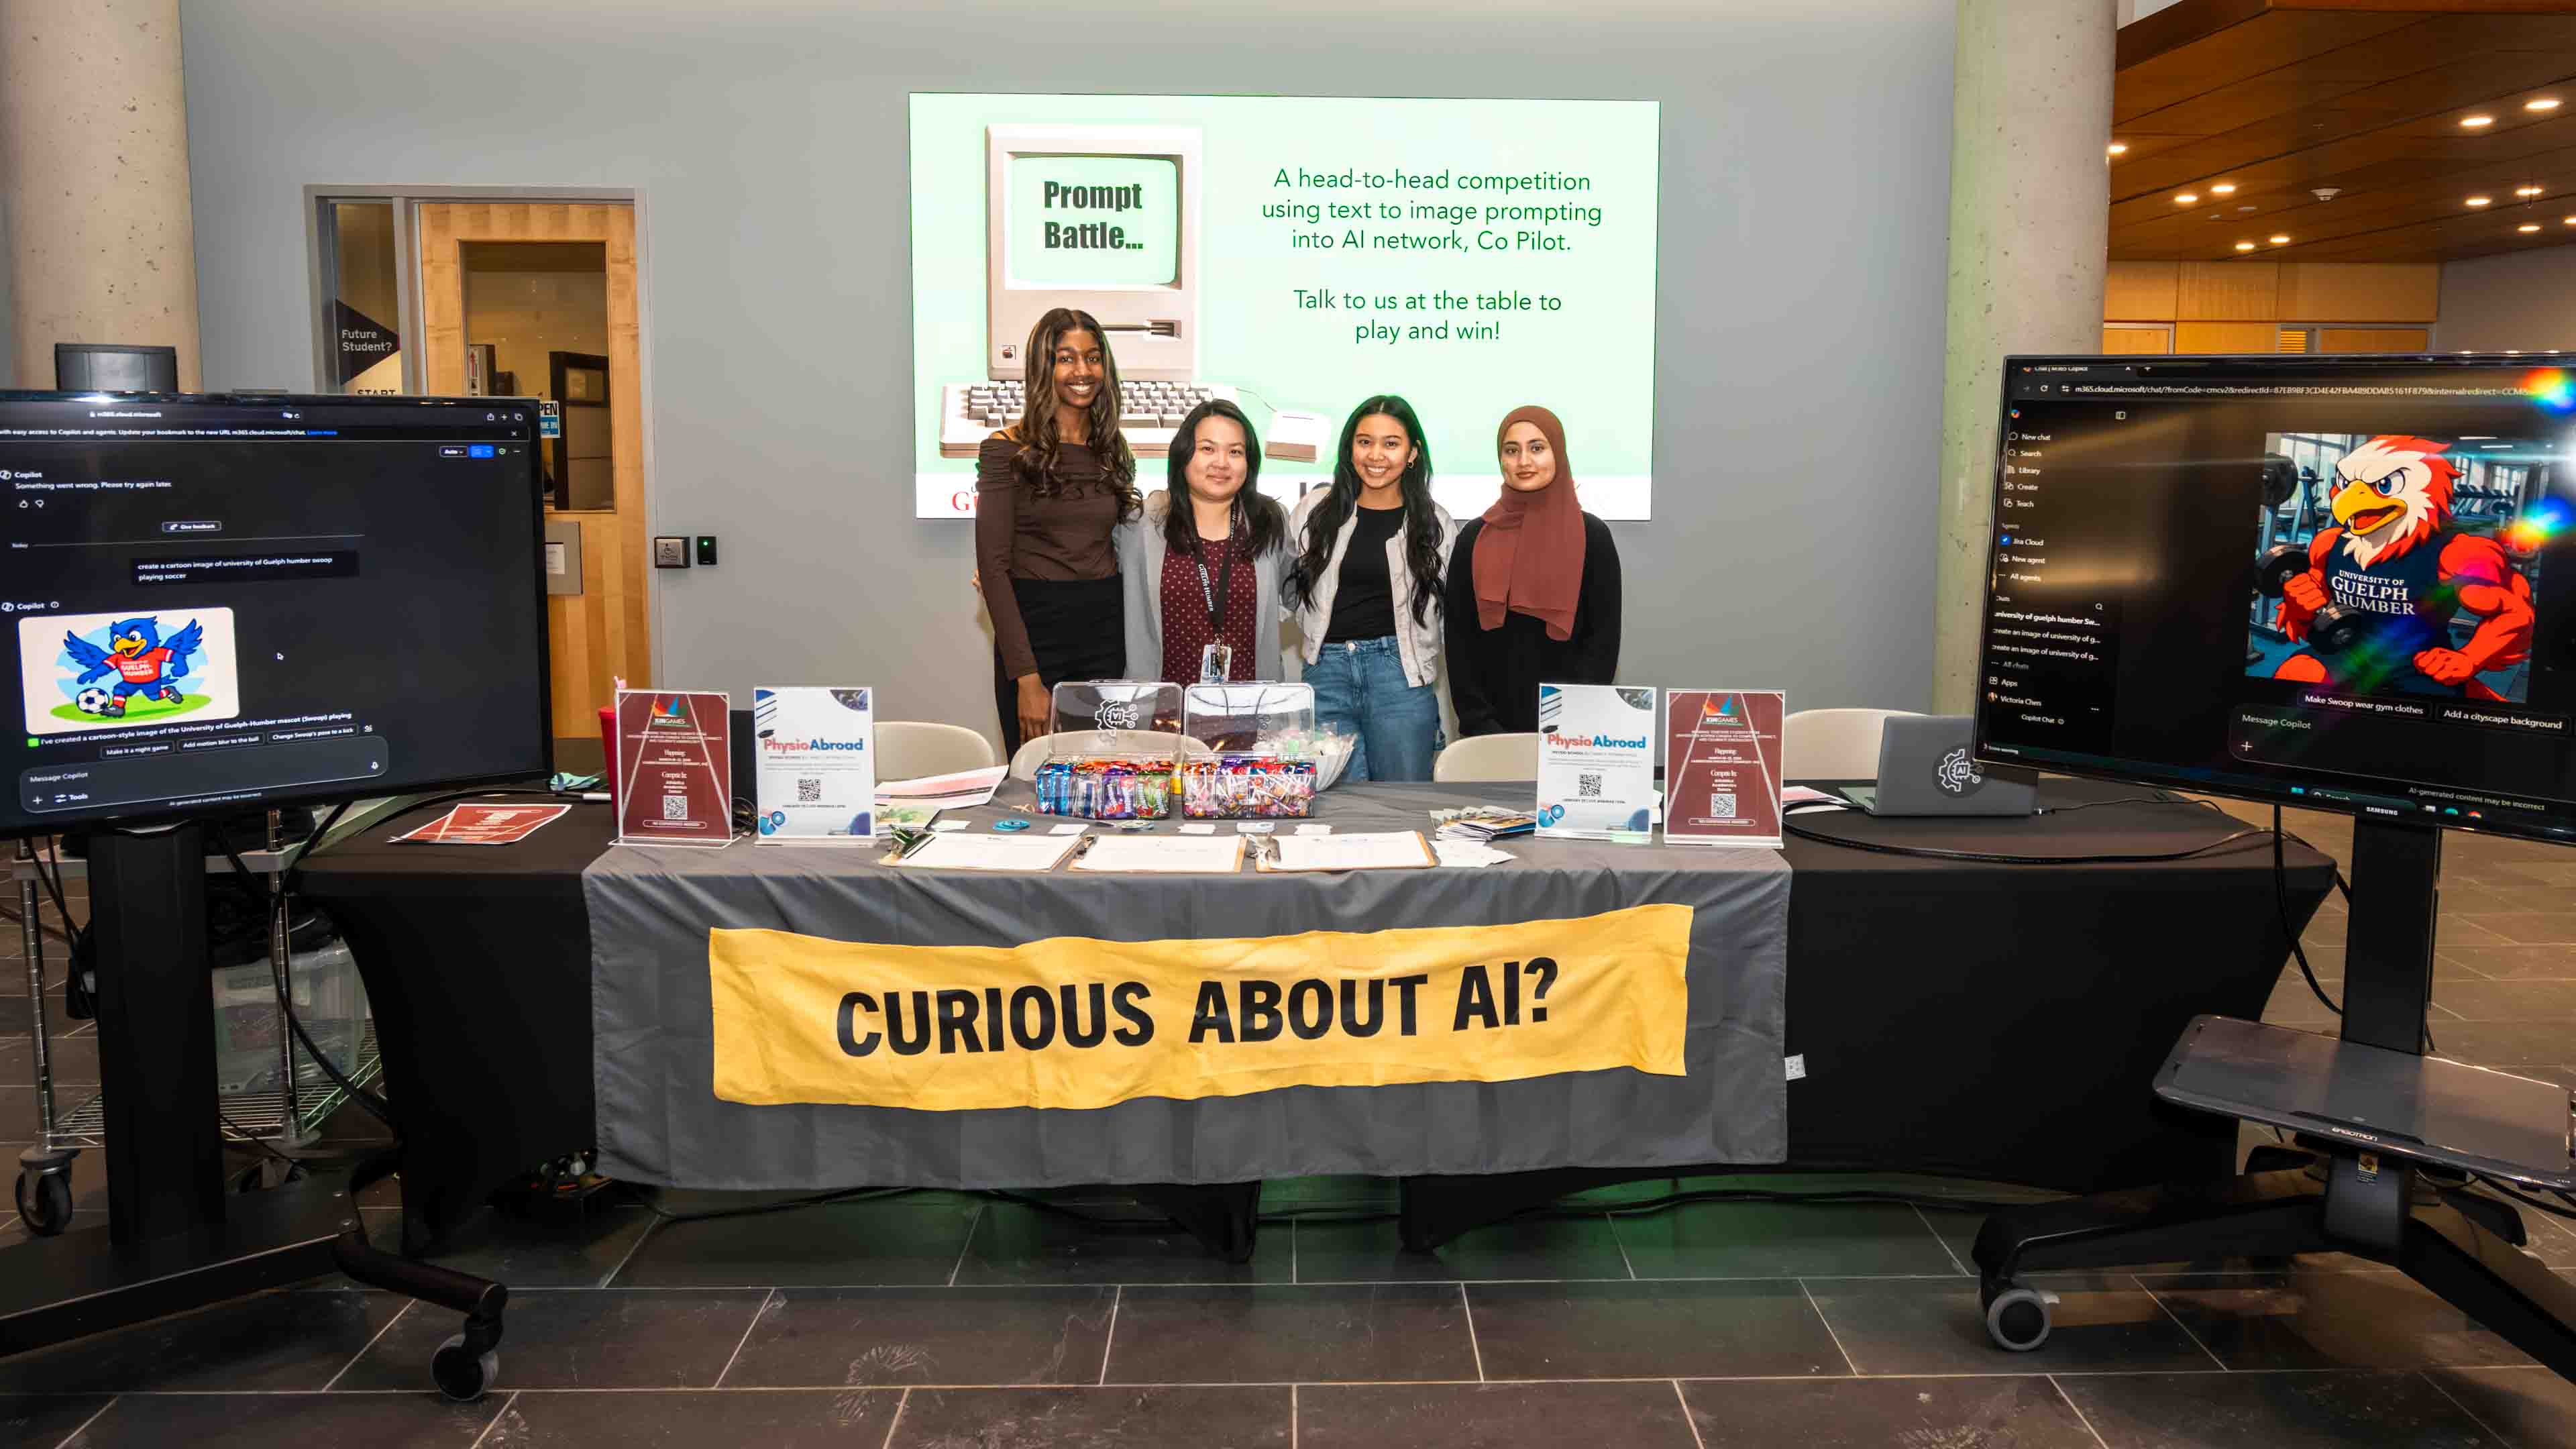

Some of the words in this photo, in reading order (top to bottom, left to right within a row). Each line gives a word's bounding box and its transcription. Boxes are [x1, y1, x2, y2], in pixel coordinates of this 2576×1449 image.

[1274, 169, 1291, 186] A
[1300, 168, 1448, 189] head-to-head
[1458, 172, 1589, 195] competition
[1044, 181, 1142, 211] Prompt
[1263, 199, 1319, 223] using
[1328, 203, 1371, 218] text
[1379, 203, 1401, 219] to
[1411, 201, 1477, 225] image
[1487, 202, 1601, 226] prompting
[1045, 222, 1143, 249] Battle...
[1293, 229, 1334, 248] into
[1342, 230, 1363, 248] AI
[1375, 229, 1468, 252] network,
[1478, 231, 1507, 250] Co
[1518, 231, 1570, 250] Pilot.
[1293, 289, 1335, 308] Talk
[1344, 293, 1365, 309] to
[1375, 297, 1397, 309] us
[1406, 294, 1426, 309] at
[1434, 290, 1468, 309] the
[1477, 290, 1531, 310] table
[1539, 295, 1561, 310] to
[342, 329, 377, 339] Future
[1356, 319, 1400, 344] play
[1409, 320, 1448, 339] and
[1457, 322, 1499, 339] win!
[342, 342, 392, 352] Student?
[223, 559, 254, 568] university
[263, 558, 286, 566] Guelph
[2339, 570, 2390, 585] UNIVERSITY
[2331, 575, 2409, 601] GUELPH
[17, 602, 45, 610] Copilot
[2335, 591, 2416, 616] HUMBER
[2034, 614, 2055, 623] guelph
[2057, 616, 2083, 625] humber
[2022, 631, 2041, 639] image
[2051, 633, 2081, 643] university
[2021, 647, 2039, 655] image
[2049, 649, 2079, 659] university
[2001, 680, 2018, 688] Apps
[2000, 695, 2024, 705] Victoria
[2305, 694, 2326, 706] Make
[2327, 697, 2354, 709] Swoop
[2355, 700, 2373, 709] wear
[2375, 702, 2394, 713] gym
[2395, 703, 2424, 714] clothes
[89, 732, 135, 741] cartoon-style
[136, 729, 158, 737] image
[181, 724, 213, 733] University
[224, 720, 276, 729] Guelph-Humber
[302, 714, 327, 722] (Swoop)
[329, 712, 352, 720] playing
[2021, 714, 2041, 723] Copilot
[2242, 714, 2279, 727] Message
[2280, 718, 2312, 731] Copilot
[2444, 709, 2461, 718] Add
[2470, 712, 2509, 725] cityscape
[2511, 716, 2563, 730] background
[764, 737, 863, 753] PhysioAbroad
[1548, 734, 1646, 749] PhysioAbroad
[30, 774, 60, 784] Message
[62, 772, 88, 780] Copilot
[1957, 766, 1966, 774] AI
[2409, 787, 2454, 799] AI-generated
[2456, 794, 2483, 803] content
[2485, 797, 2500, 806] may
[2501, 798, 2511, 806] be
[2512, 800, 2544, 810] incorrect
[2366, 806, 2398, 816] SAMSUNG
[837, 981, 1154, 1057] CURIOUS
[1189, 974, 1428, 1042] ABOUT
[1453, 957, 1558, 1031] AI?
